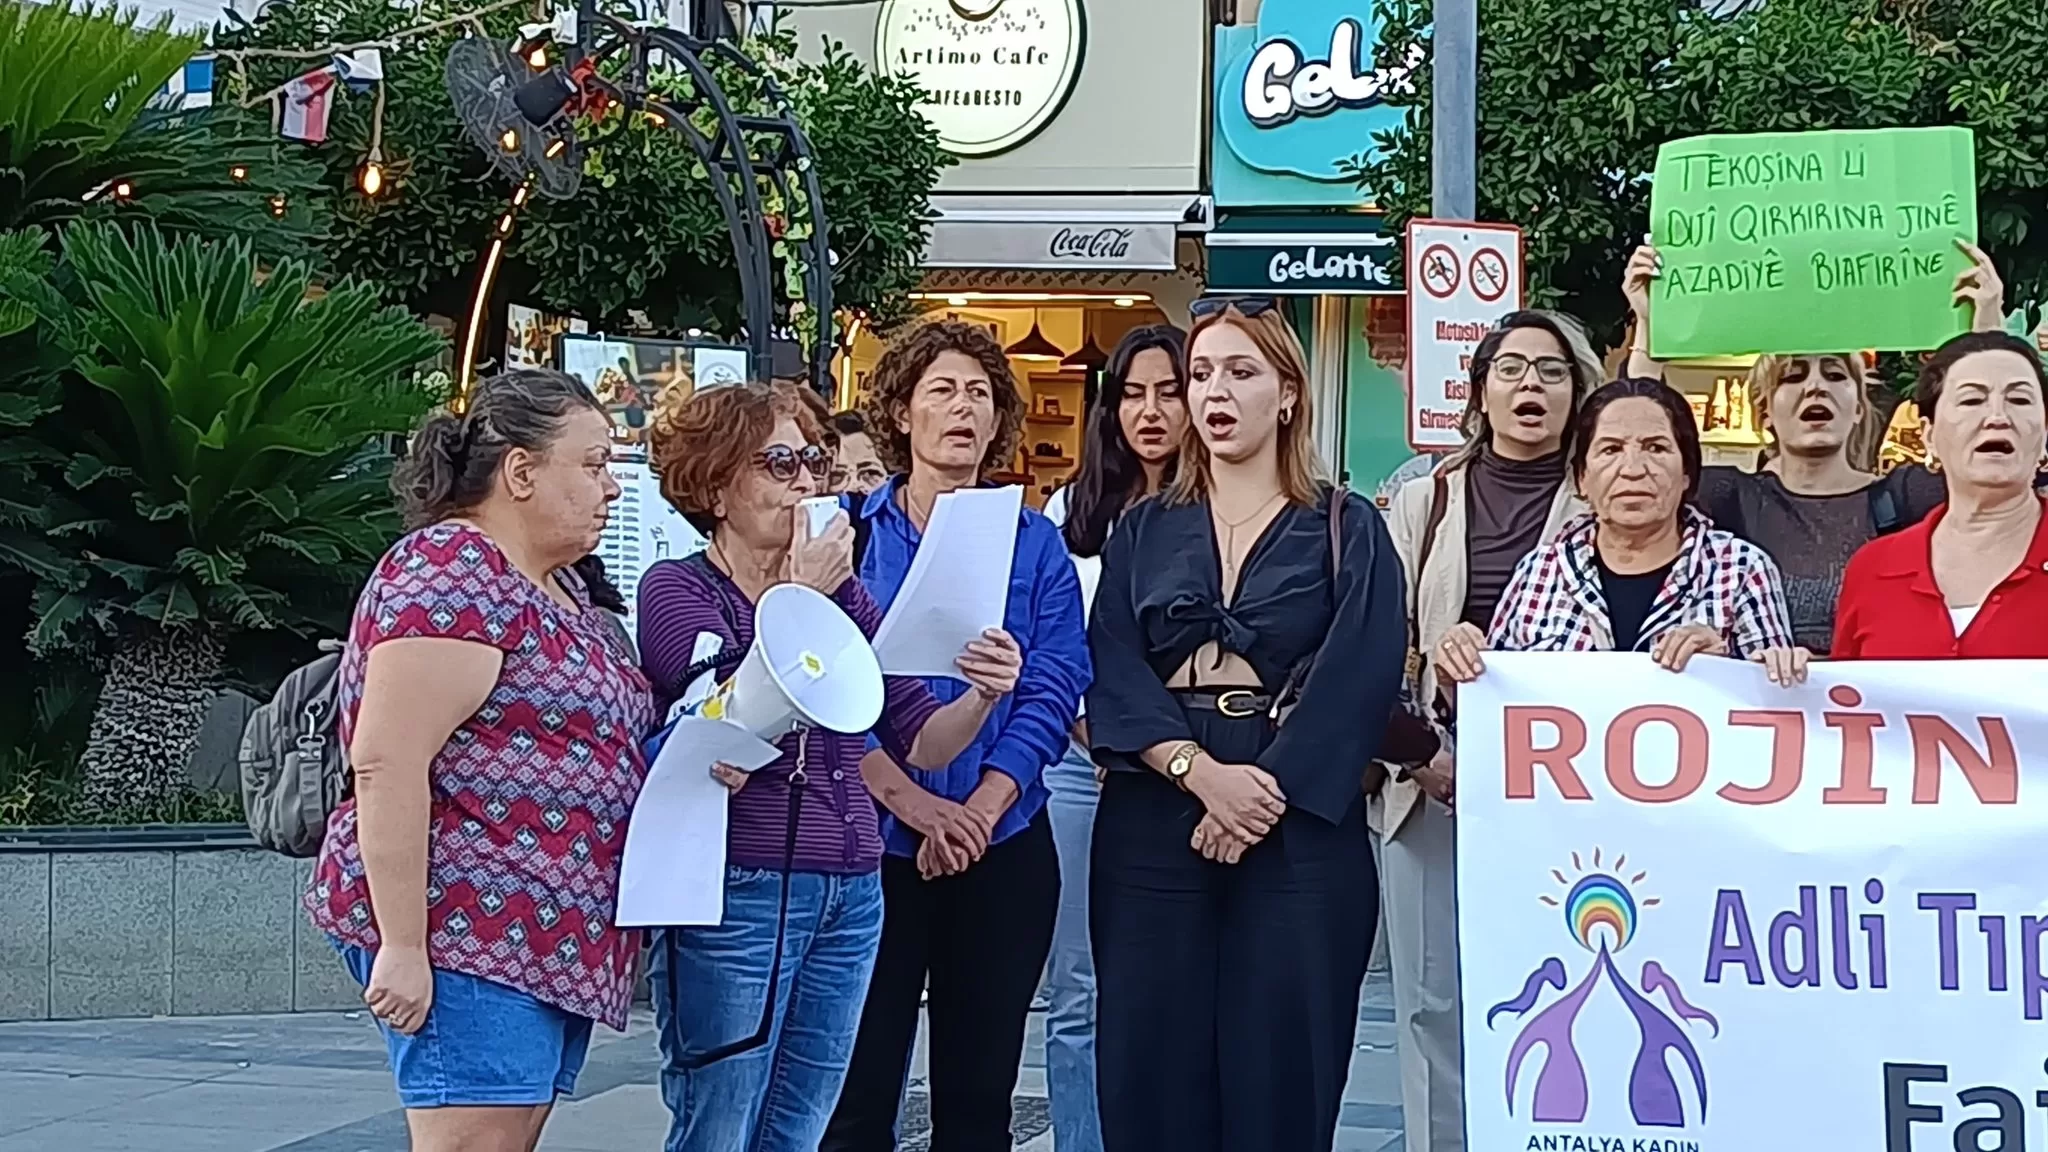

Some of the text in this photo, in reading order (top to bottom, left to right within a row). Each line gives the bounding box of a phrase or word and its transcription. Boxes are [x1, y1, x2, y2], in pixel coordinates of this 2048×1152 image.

[993, 46, 1049, 65] Cafe
[1730, 204, 1883, 244] QIRKIRINA
[1896, 193, 1960, 238] JINÊ
[1503, 685, 2019, 805] ROJİN
[1704, 878, 1888, 990] Adli
[1527, 1135, 1699, 1152] ANTALYA KADIN
